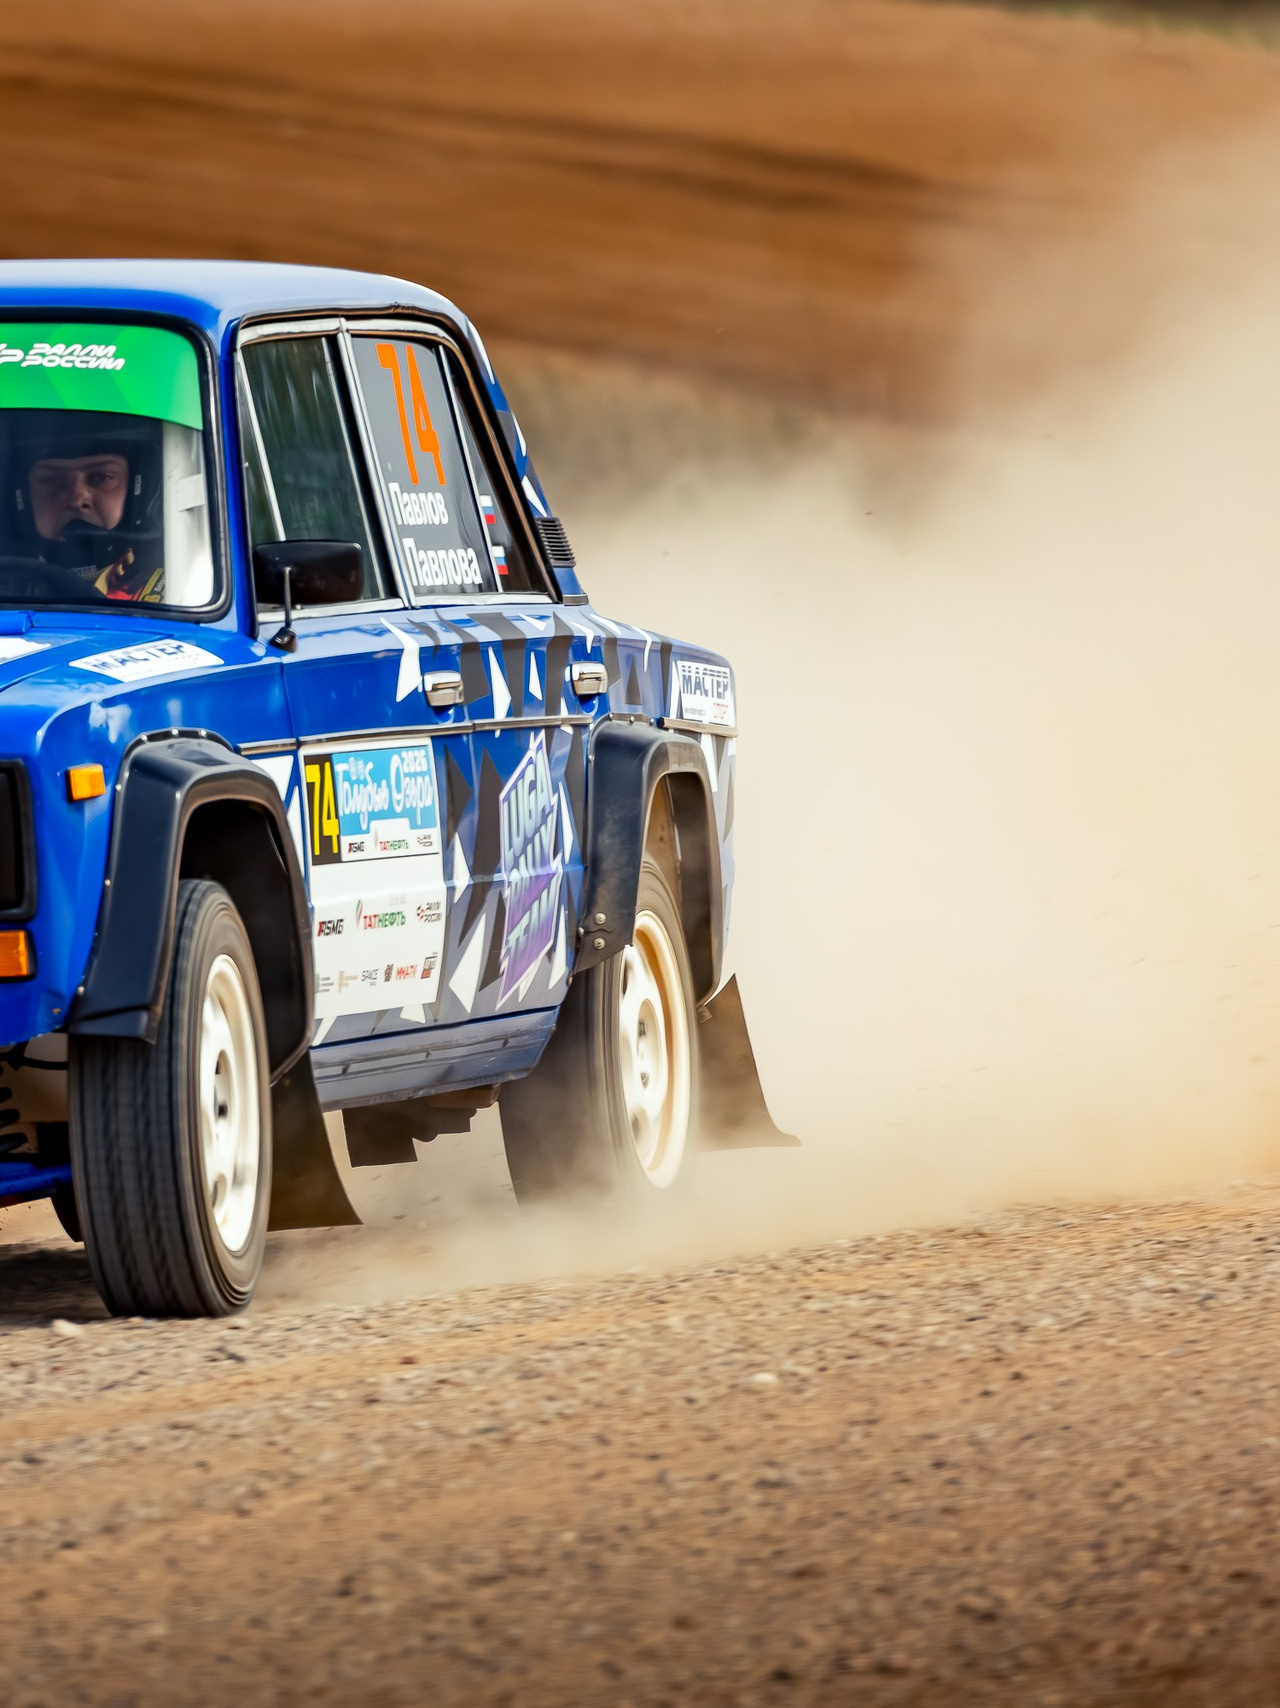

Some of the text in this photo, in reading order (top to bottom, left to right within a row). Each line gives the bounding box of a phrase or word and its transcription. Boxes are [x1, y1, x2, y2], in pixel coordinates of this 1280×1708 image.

[20, 355, 126, 370] РОССИИ
[28, 343, 117, 357] РАЛЛИ
[375, 343, 446, 486] 74
[388, 482, 449, 526] Павлов
[402, 538, 483, 587] Павлова
[305, 762, 340, 855] 74
[503, 749, 550, 873] LUGA
[363, 911, 406, 930] ТАТНЕФТЬ
